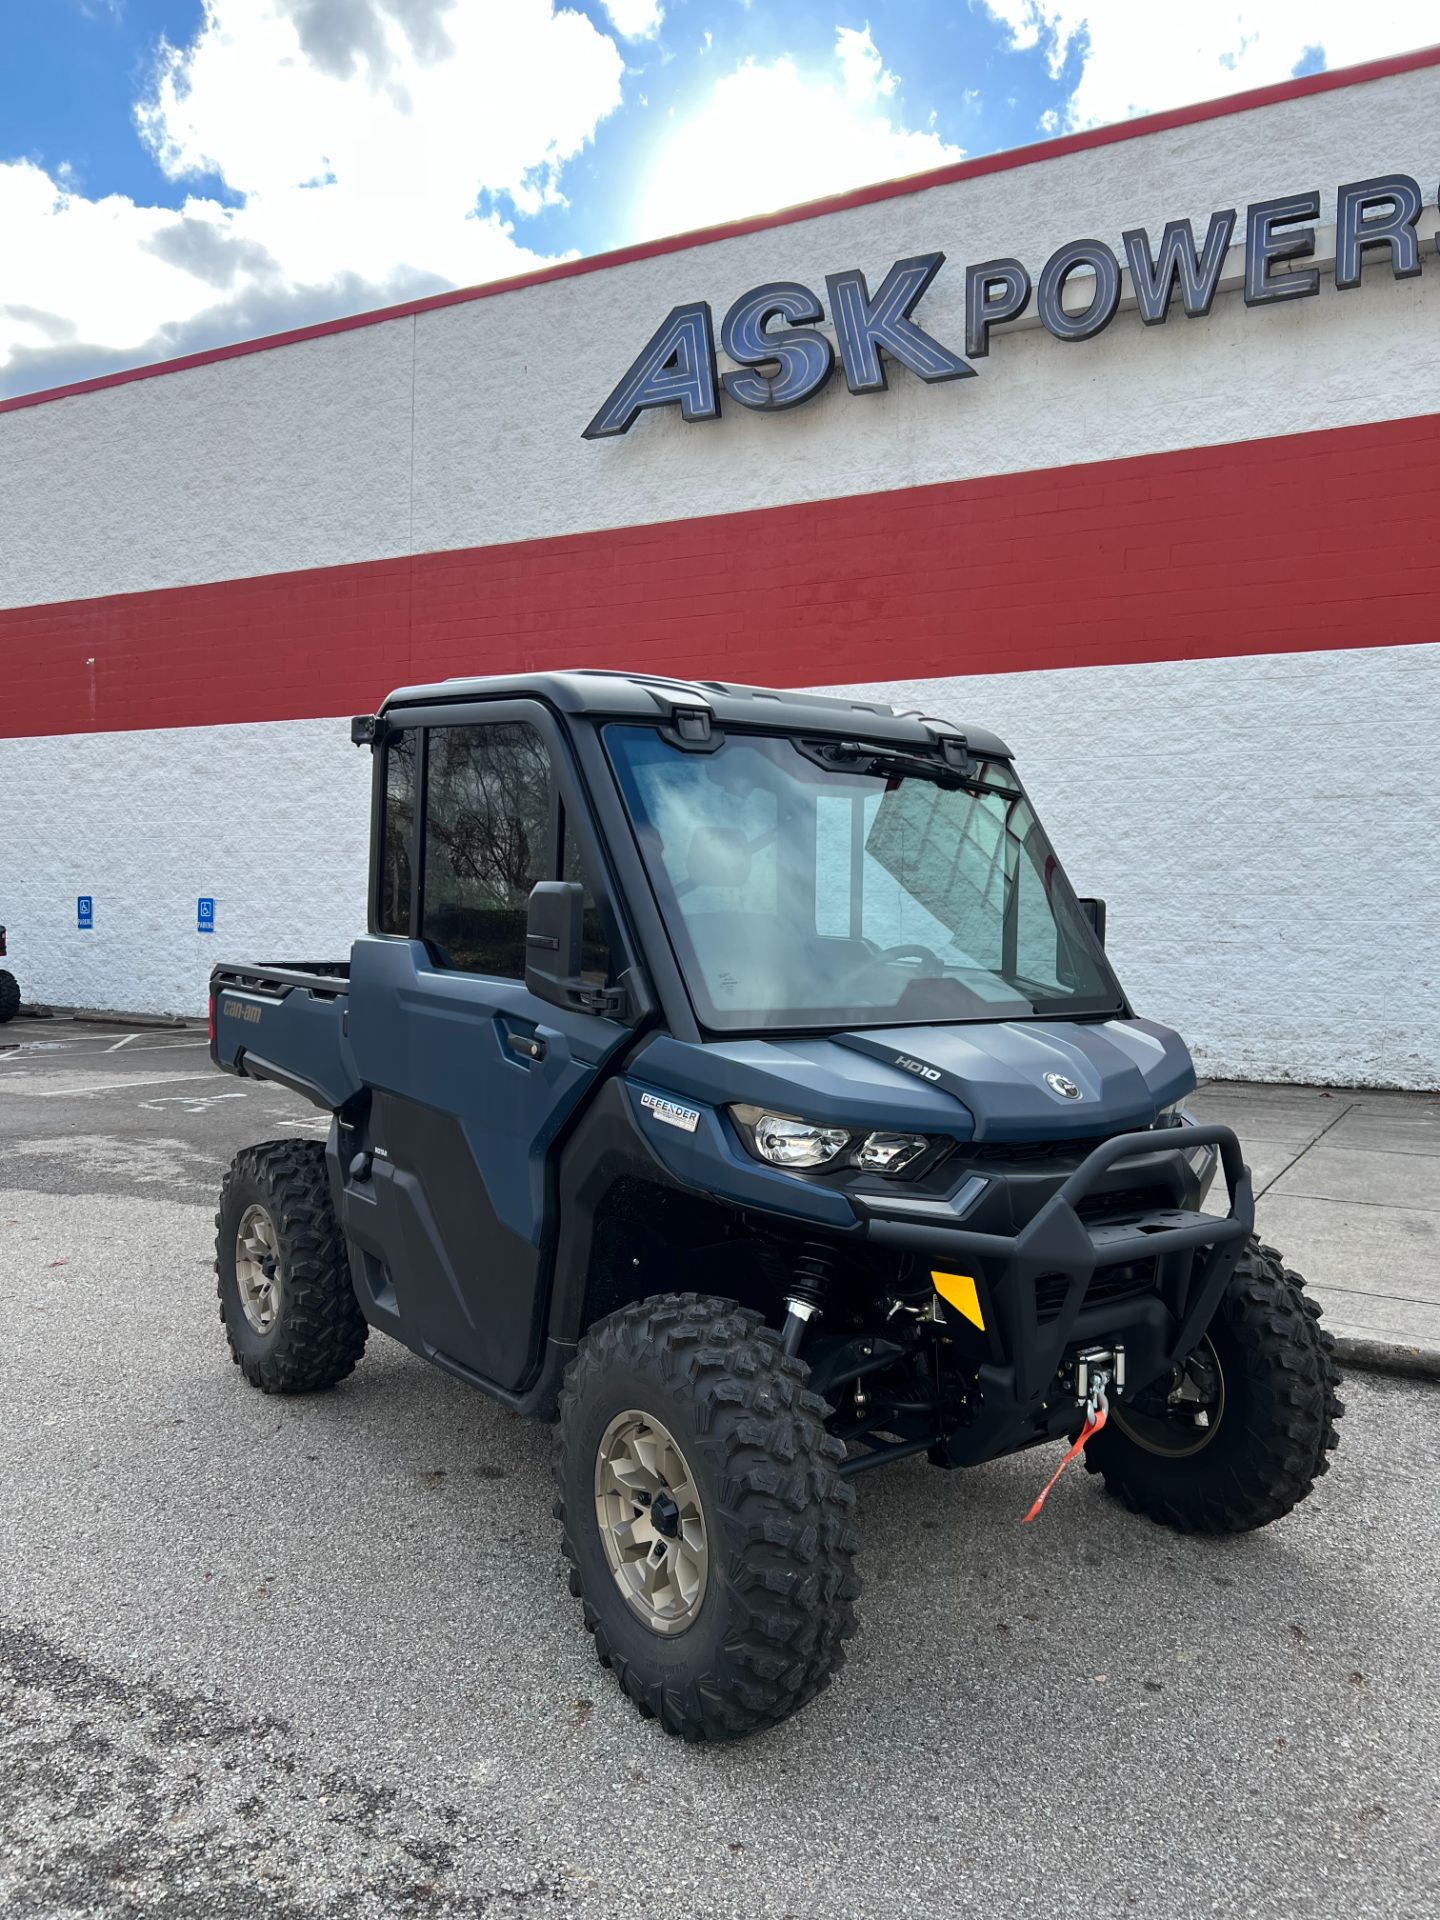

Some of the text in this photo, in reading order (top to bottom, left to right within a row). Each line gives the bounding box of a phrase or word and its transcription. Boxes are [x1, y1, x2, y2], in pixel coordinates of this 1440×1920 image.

[581, 174, 1440, 440] ASK POWER
[224, 1000, 261, 1023] can-am
[895, 1055, 942, 1081] HD10
[642, 1095, 697, 1122] DEFENDER
